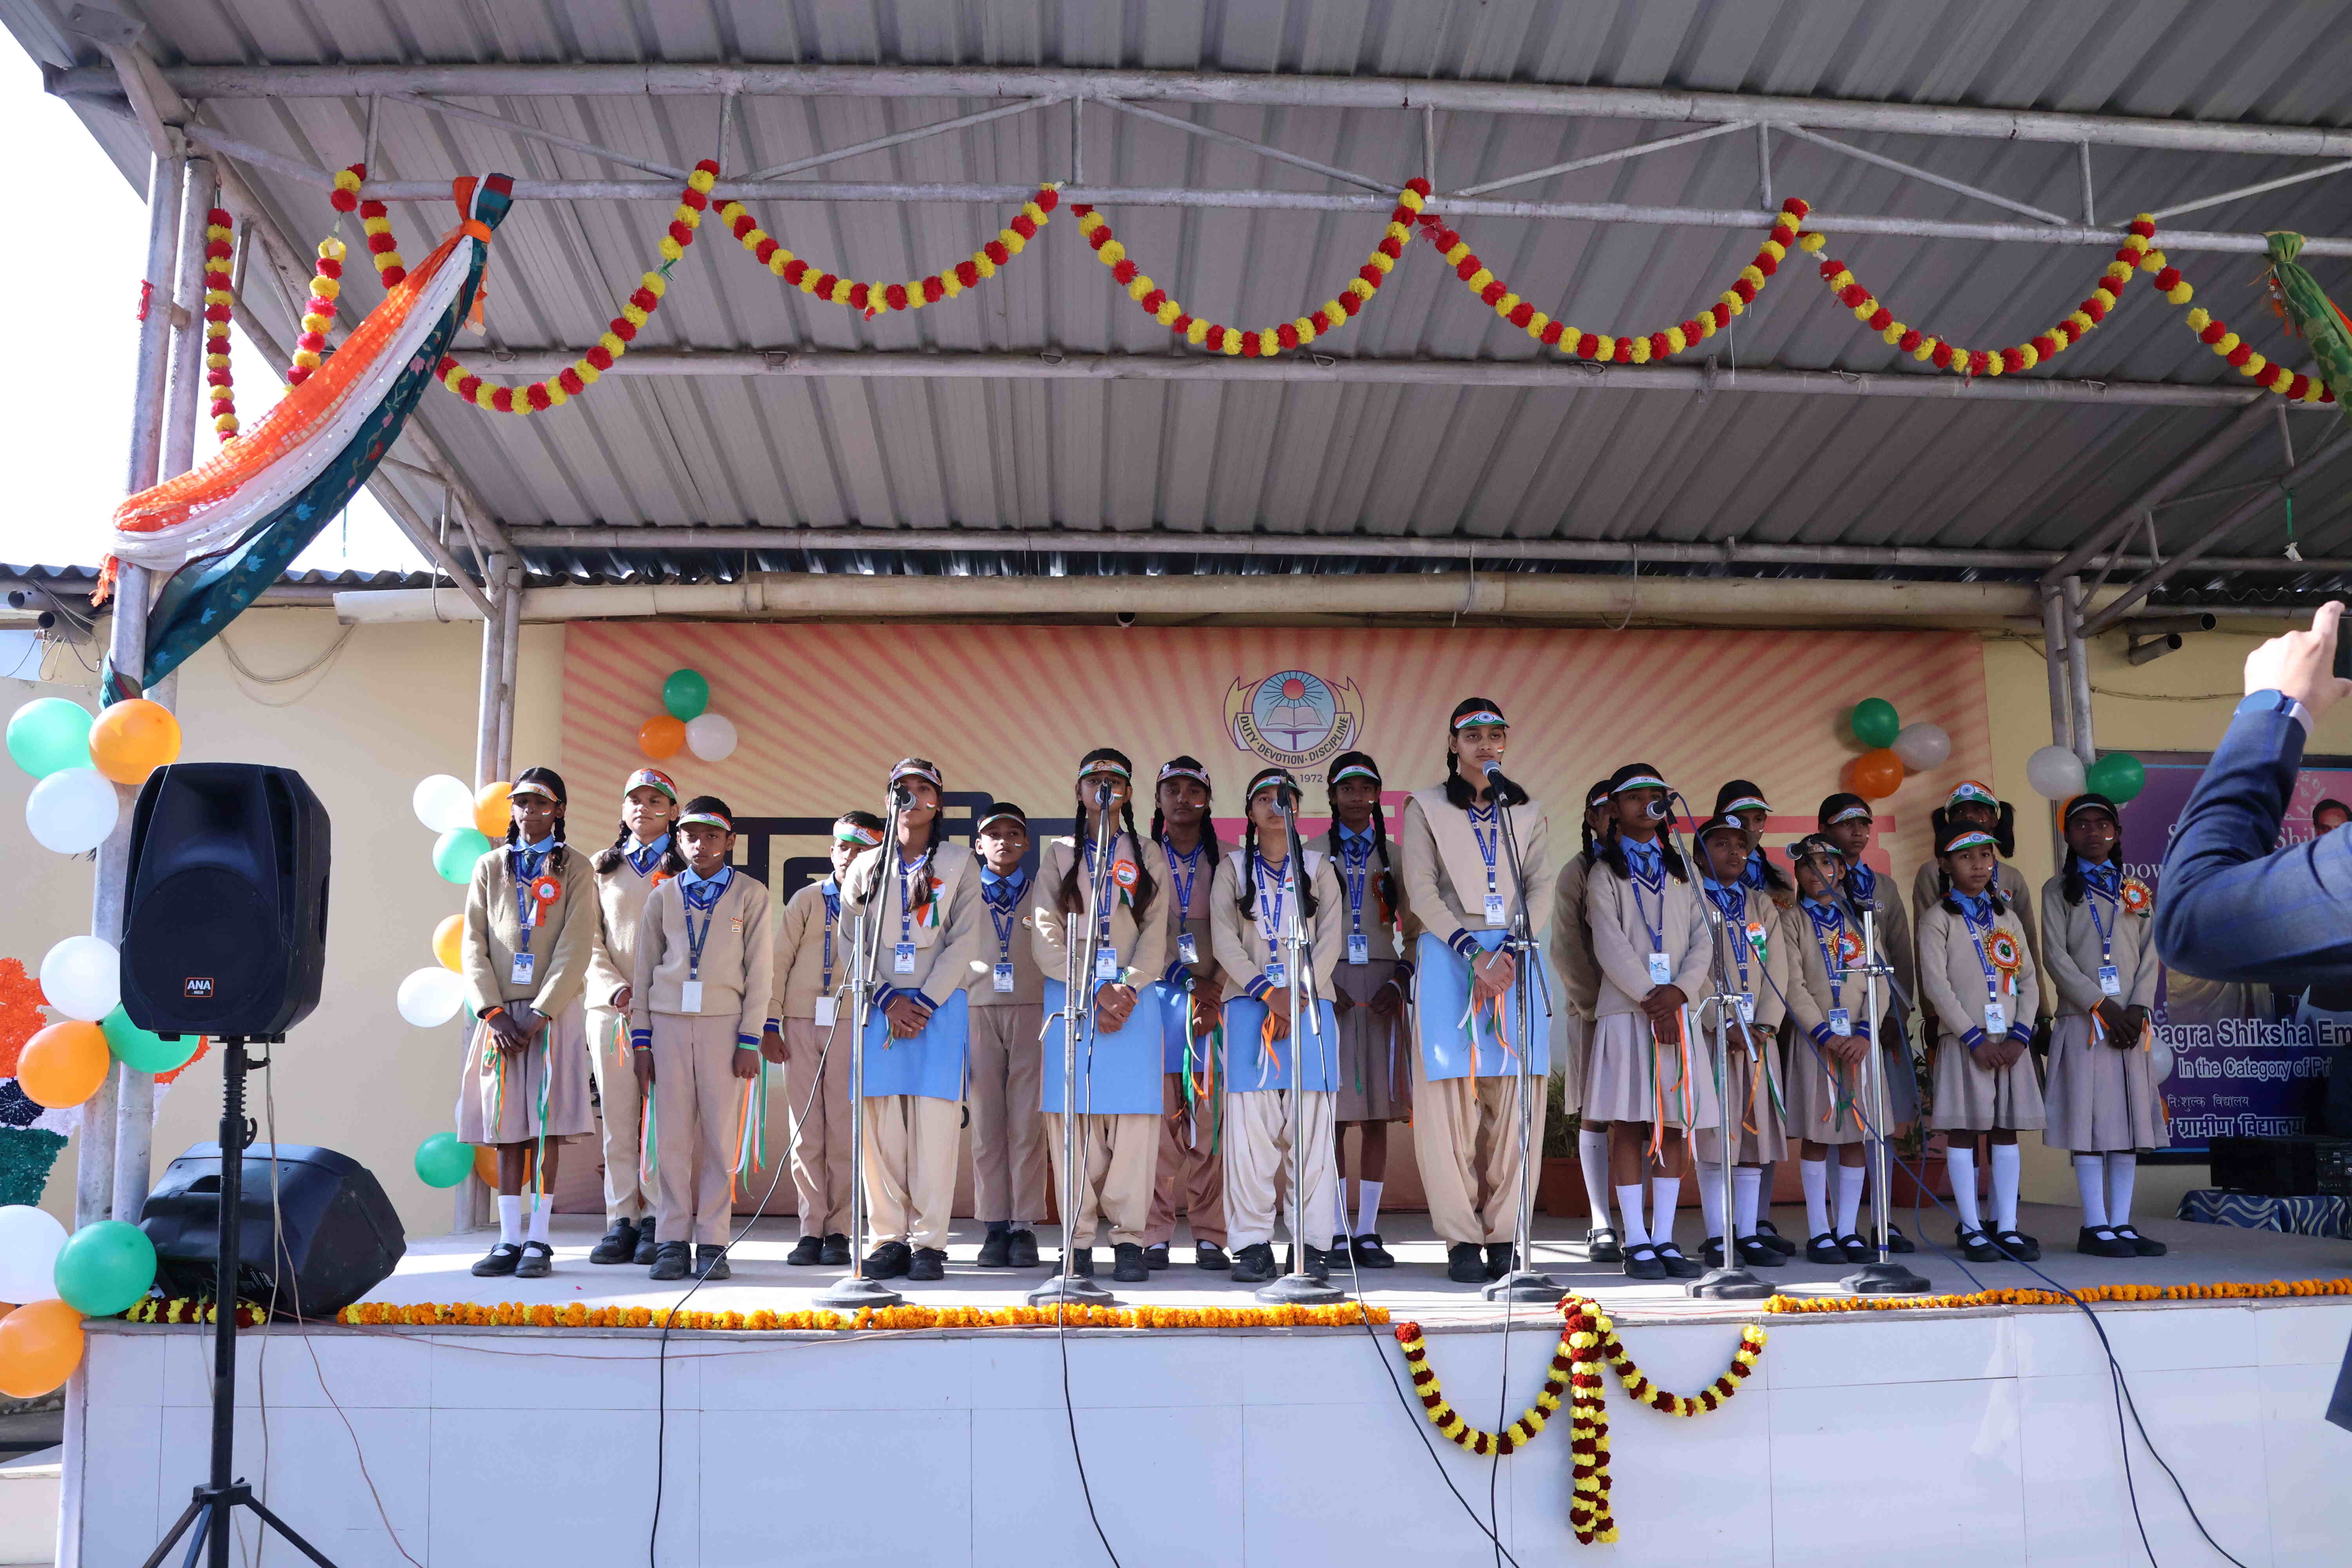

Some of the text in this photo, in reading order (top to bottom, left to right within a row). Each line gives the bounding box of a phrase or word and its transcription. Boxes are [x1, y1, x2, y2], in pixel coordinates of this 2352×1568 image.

[1240, 715, 1348, 764] DUTY DEVOTION DISCIPLINE
[1300, 774, 1323, 783] 1972
[187, 980, 211, 990] ANA
[2217, 1018, 2314, 1047] Shiksha
[2316, 1018, 2352, 1046] Em
[2178, 1057, 2194, 1078] In
[2195, 1056, 2222, 1078] the
[2223, 1056, 2292, 1082] Category
[2292, 1056, 2310, 1077] of
[2212, 1094, 2250, 1108] विद्यालय
[2177, 1113, 2235, 1139] ग्रामीण
[2238, 1112, 2306, 1137] विद्यालय
